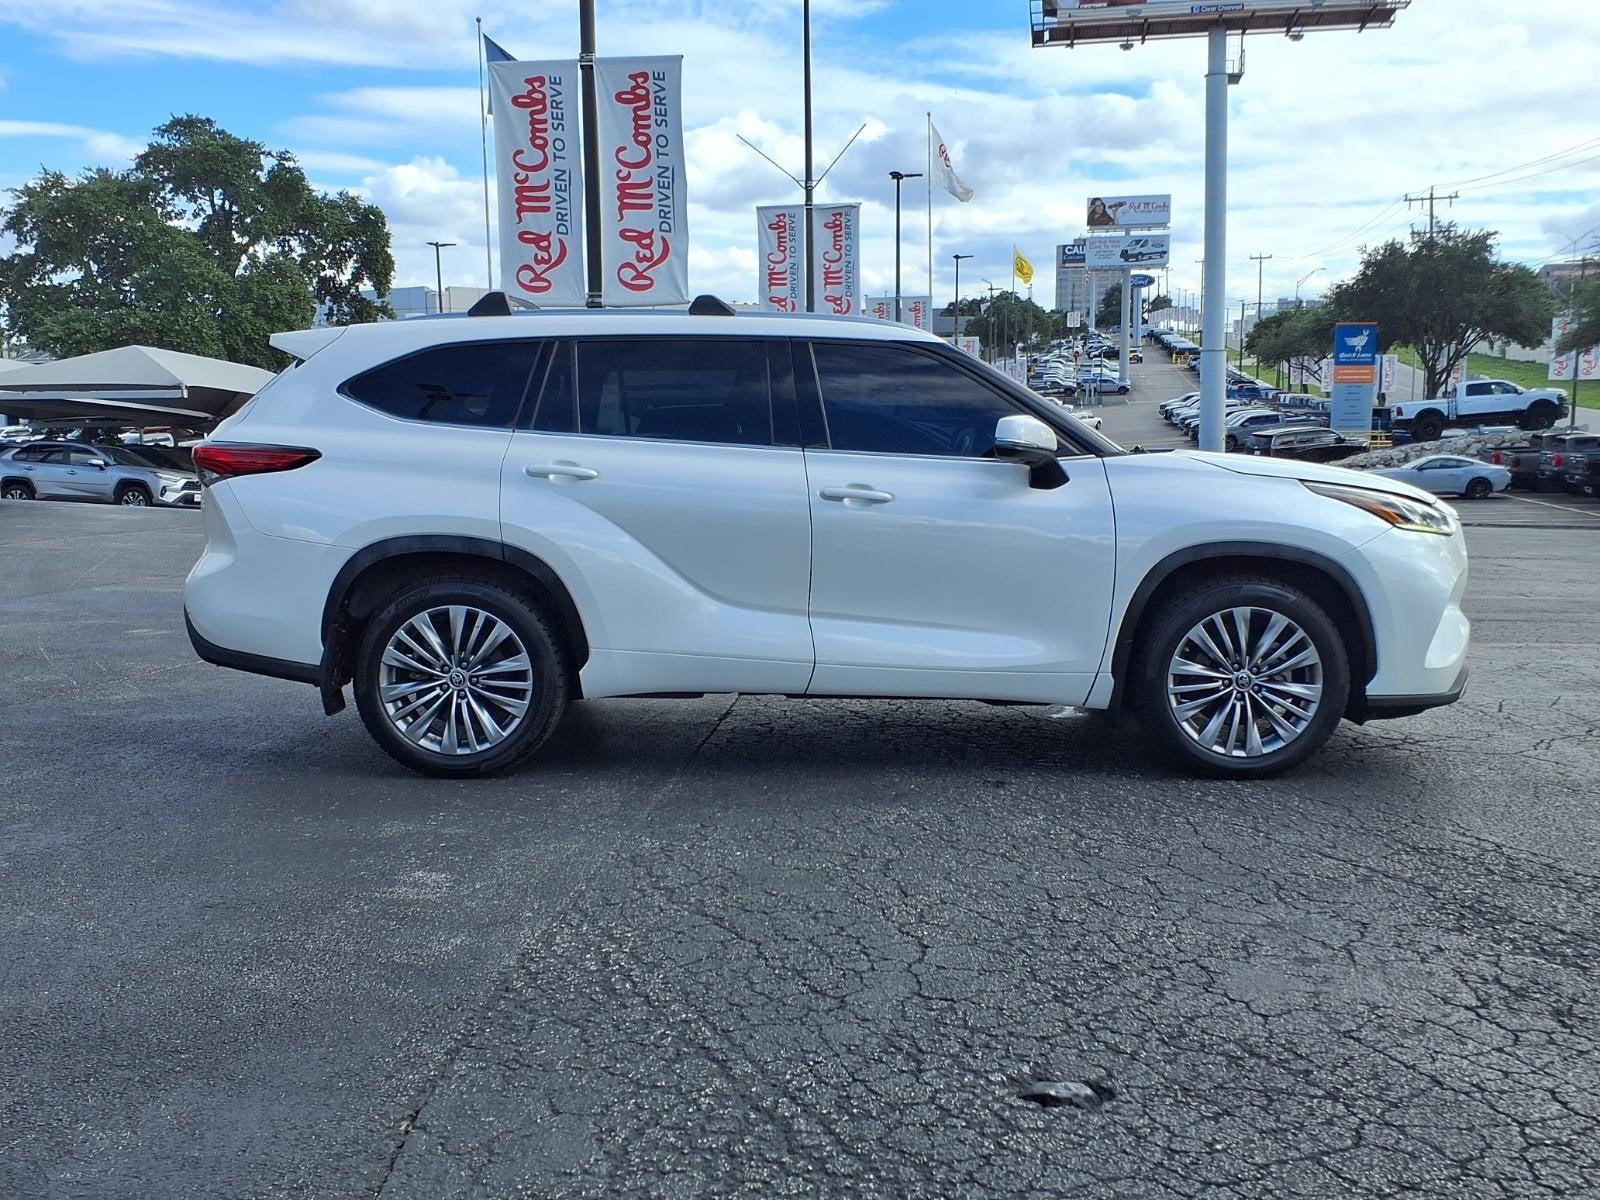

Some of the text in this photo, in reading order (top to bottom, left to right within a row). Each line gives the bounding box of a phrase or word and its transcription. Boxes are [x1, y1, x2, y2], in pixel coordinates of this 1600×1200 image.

[511, 75, 567, 293] Red McCombs
[548, 75, 569, 236] DRIVEN TO SERVE
[614, 71, 670, 292] Red McCombs
[652, 70, 672, 234] DRIVEN TO SERVE
[767, 213, 788, 292] McCombs
[788, 213, 797, 299] DRIVEN TO SERVE
[822, 212, 843, 292] McCombs
[844, 210, 852, 298] DRIVEN TO SERVE
